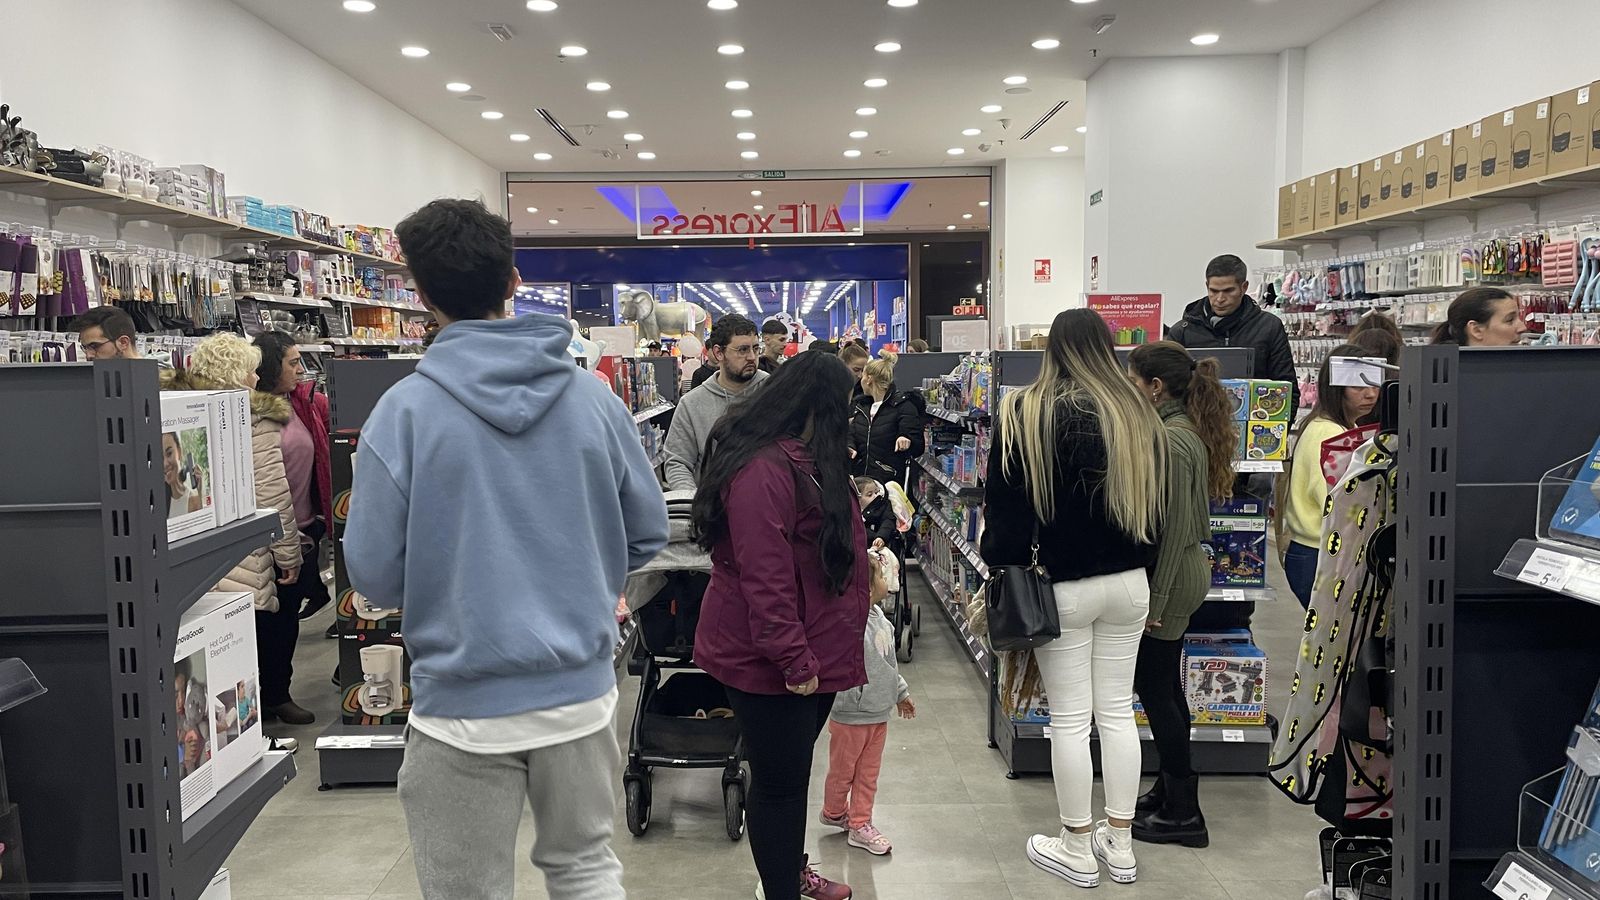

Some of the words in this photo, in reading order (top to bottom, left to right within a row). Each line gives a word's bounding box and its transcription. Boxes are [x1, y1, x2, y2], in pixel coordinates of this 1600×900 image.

[178, 415, 200, 424] Massager
[224, 602, 251, 620] InnovaGoods
[209, 640, 218, 649] Hot
[219, 631, 234, 642] Cuddly
[210, 642, 230, 658] Elephant
